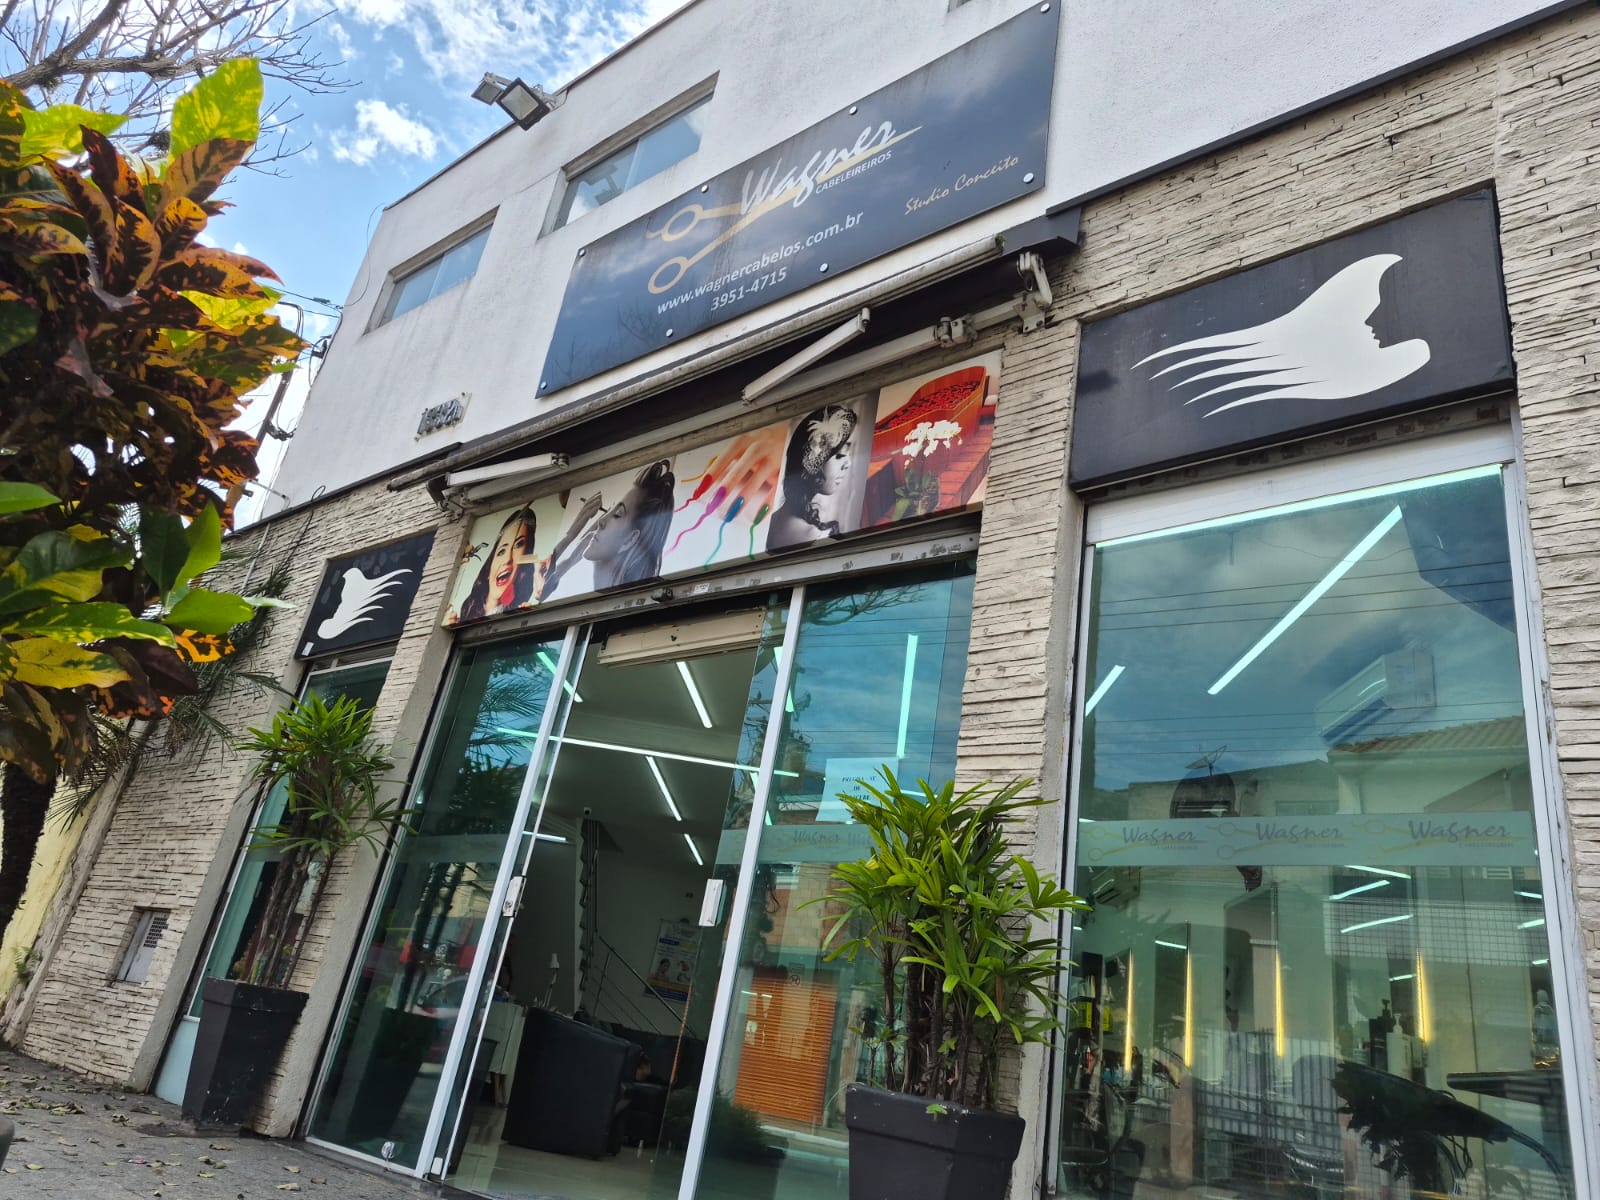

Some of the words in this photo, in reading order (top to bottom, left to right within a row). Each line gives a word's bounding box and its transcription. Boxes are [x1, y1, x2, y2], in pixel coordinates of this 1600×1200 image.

[740, 120, 896, 215] Wagner
[815, 150, 892, 194] CABELEIREIROS
[904, 187, 950, 216] Studio
[954, 155, 1020, 191] Conceito
[656, 211, 864, 315] www.wagnercabelos.com.br
[710, 267, 787, 312] 3951-4715
[1122, 826, 1197, 846] Wagner
[1255, 822, 1343, 844] Wagner
[1407, 820, 1512, 843] Wagner
